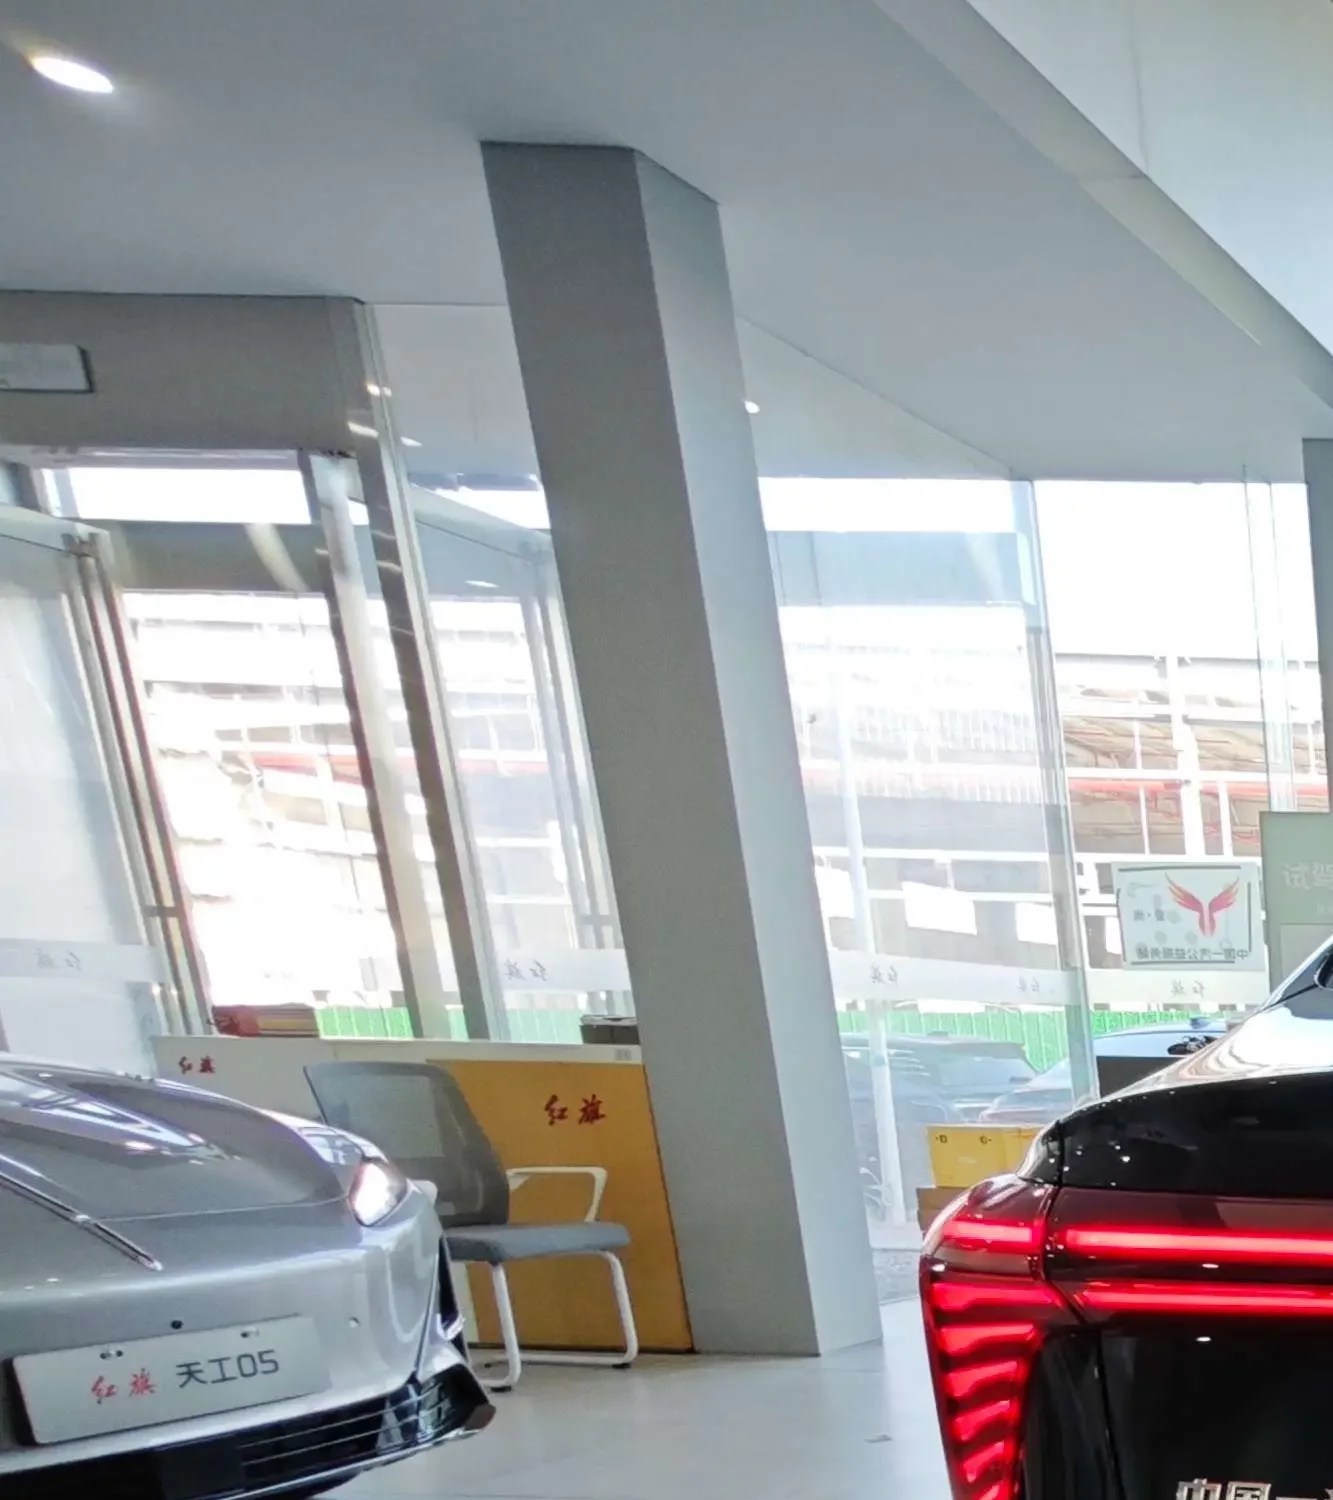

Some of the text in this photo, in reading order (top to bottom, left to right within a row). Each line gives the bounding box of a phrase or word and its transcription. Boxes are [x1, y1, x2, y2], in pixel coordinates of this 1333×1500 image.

[544, 1093, 606, 1127] 红旗
[91, 1349, 280, 1405] 红旗 天工05
